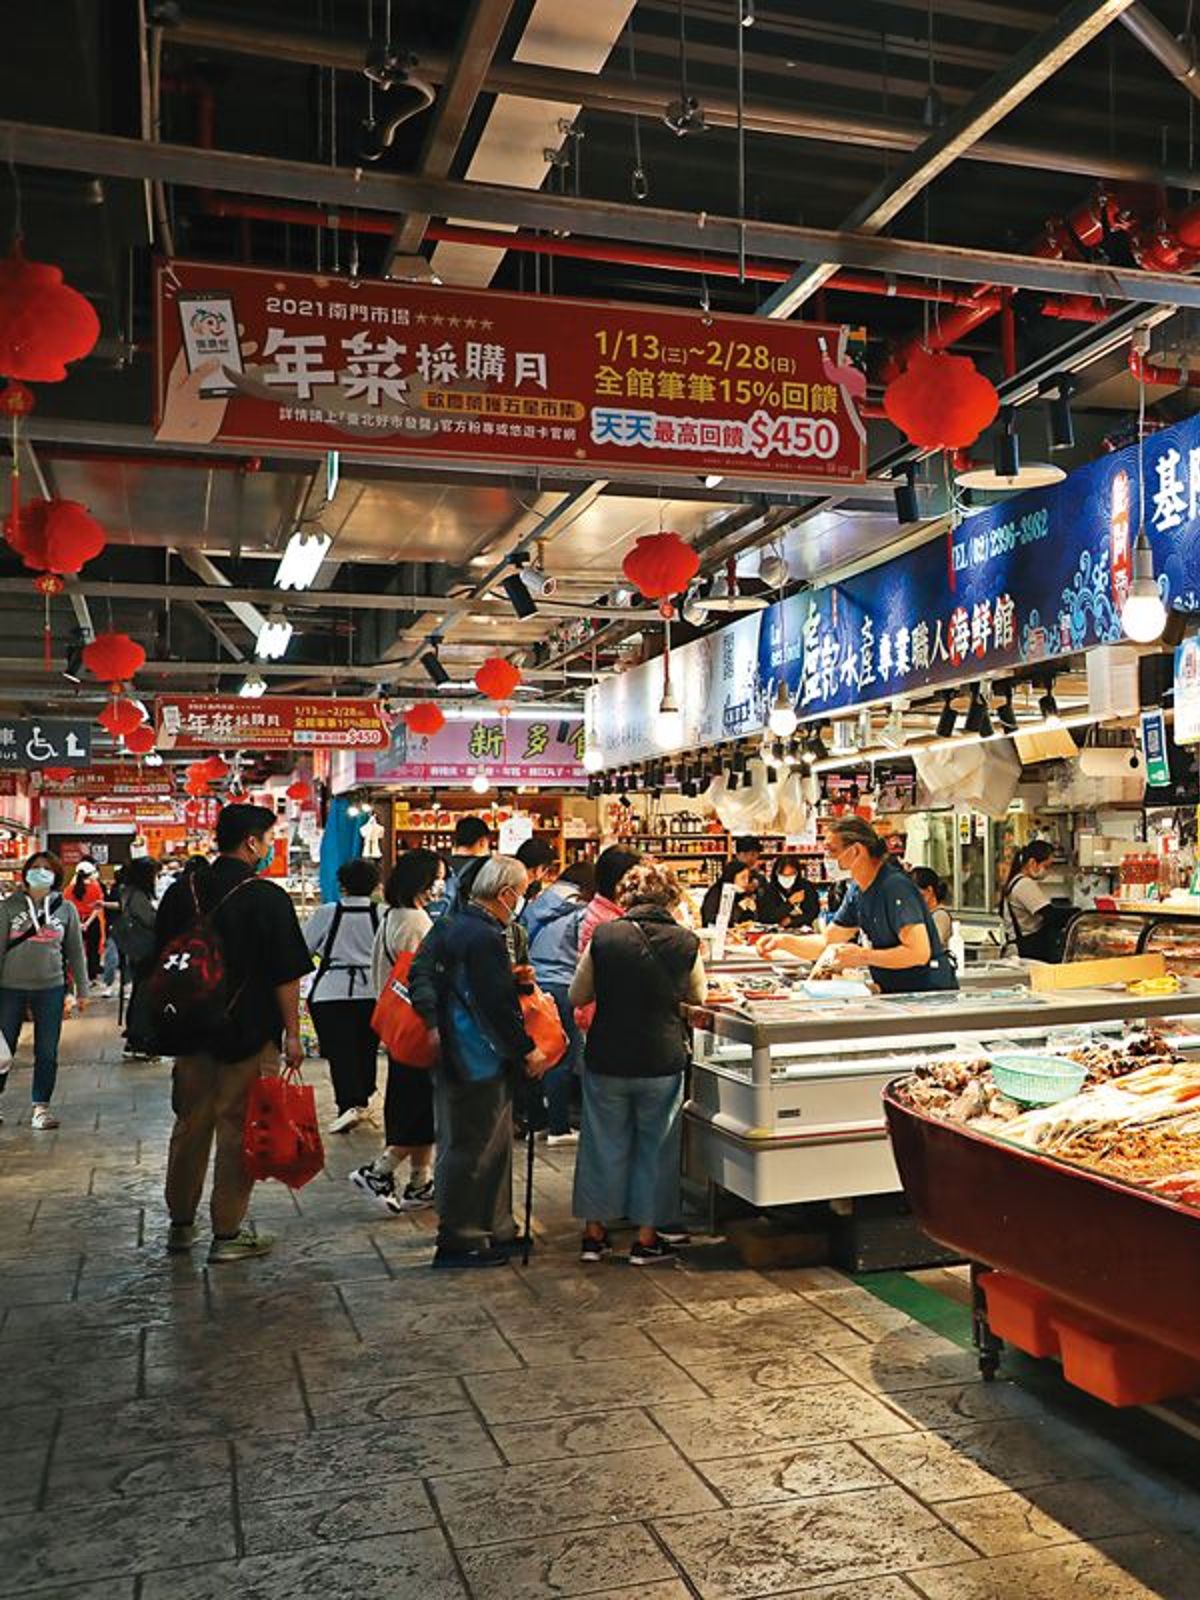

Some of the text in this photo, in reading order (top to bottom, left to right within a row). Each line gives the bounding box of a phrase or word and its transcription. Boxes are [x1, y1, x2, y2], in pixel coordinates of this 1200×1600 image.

[266, 297, 411, 326] 2021南門市場
[262, 327, 547, 406] 年菜採購月
[595, 365, 838, 415] 全館筆筆15%回饋
